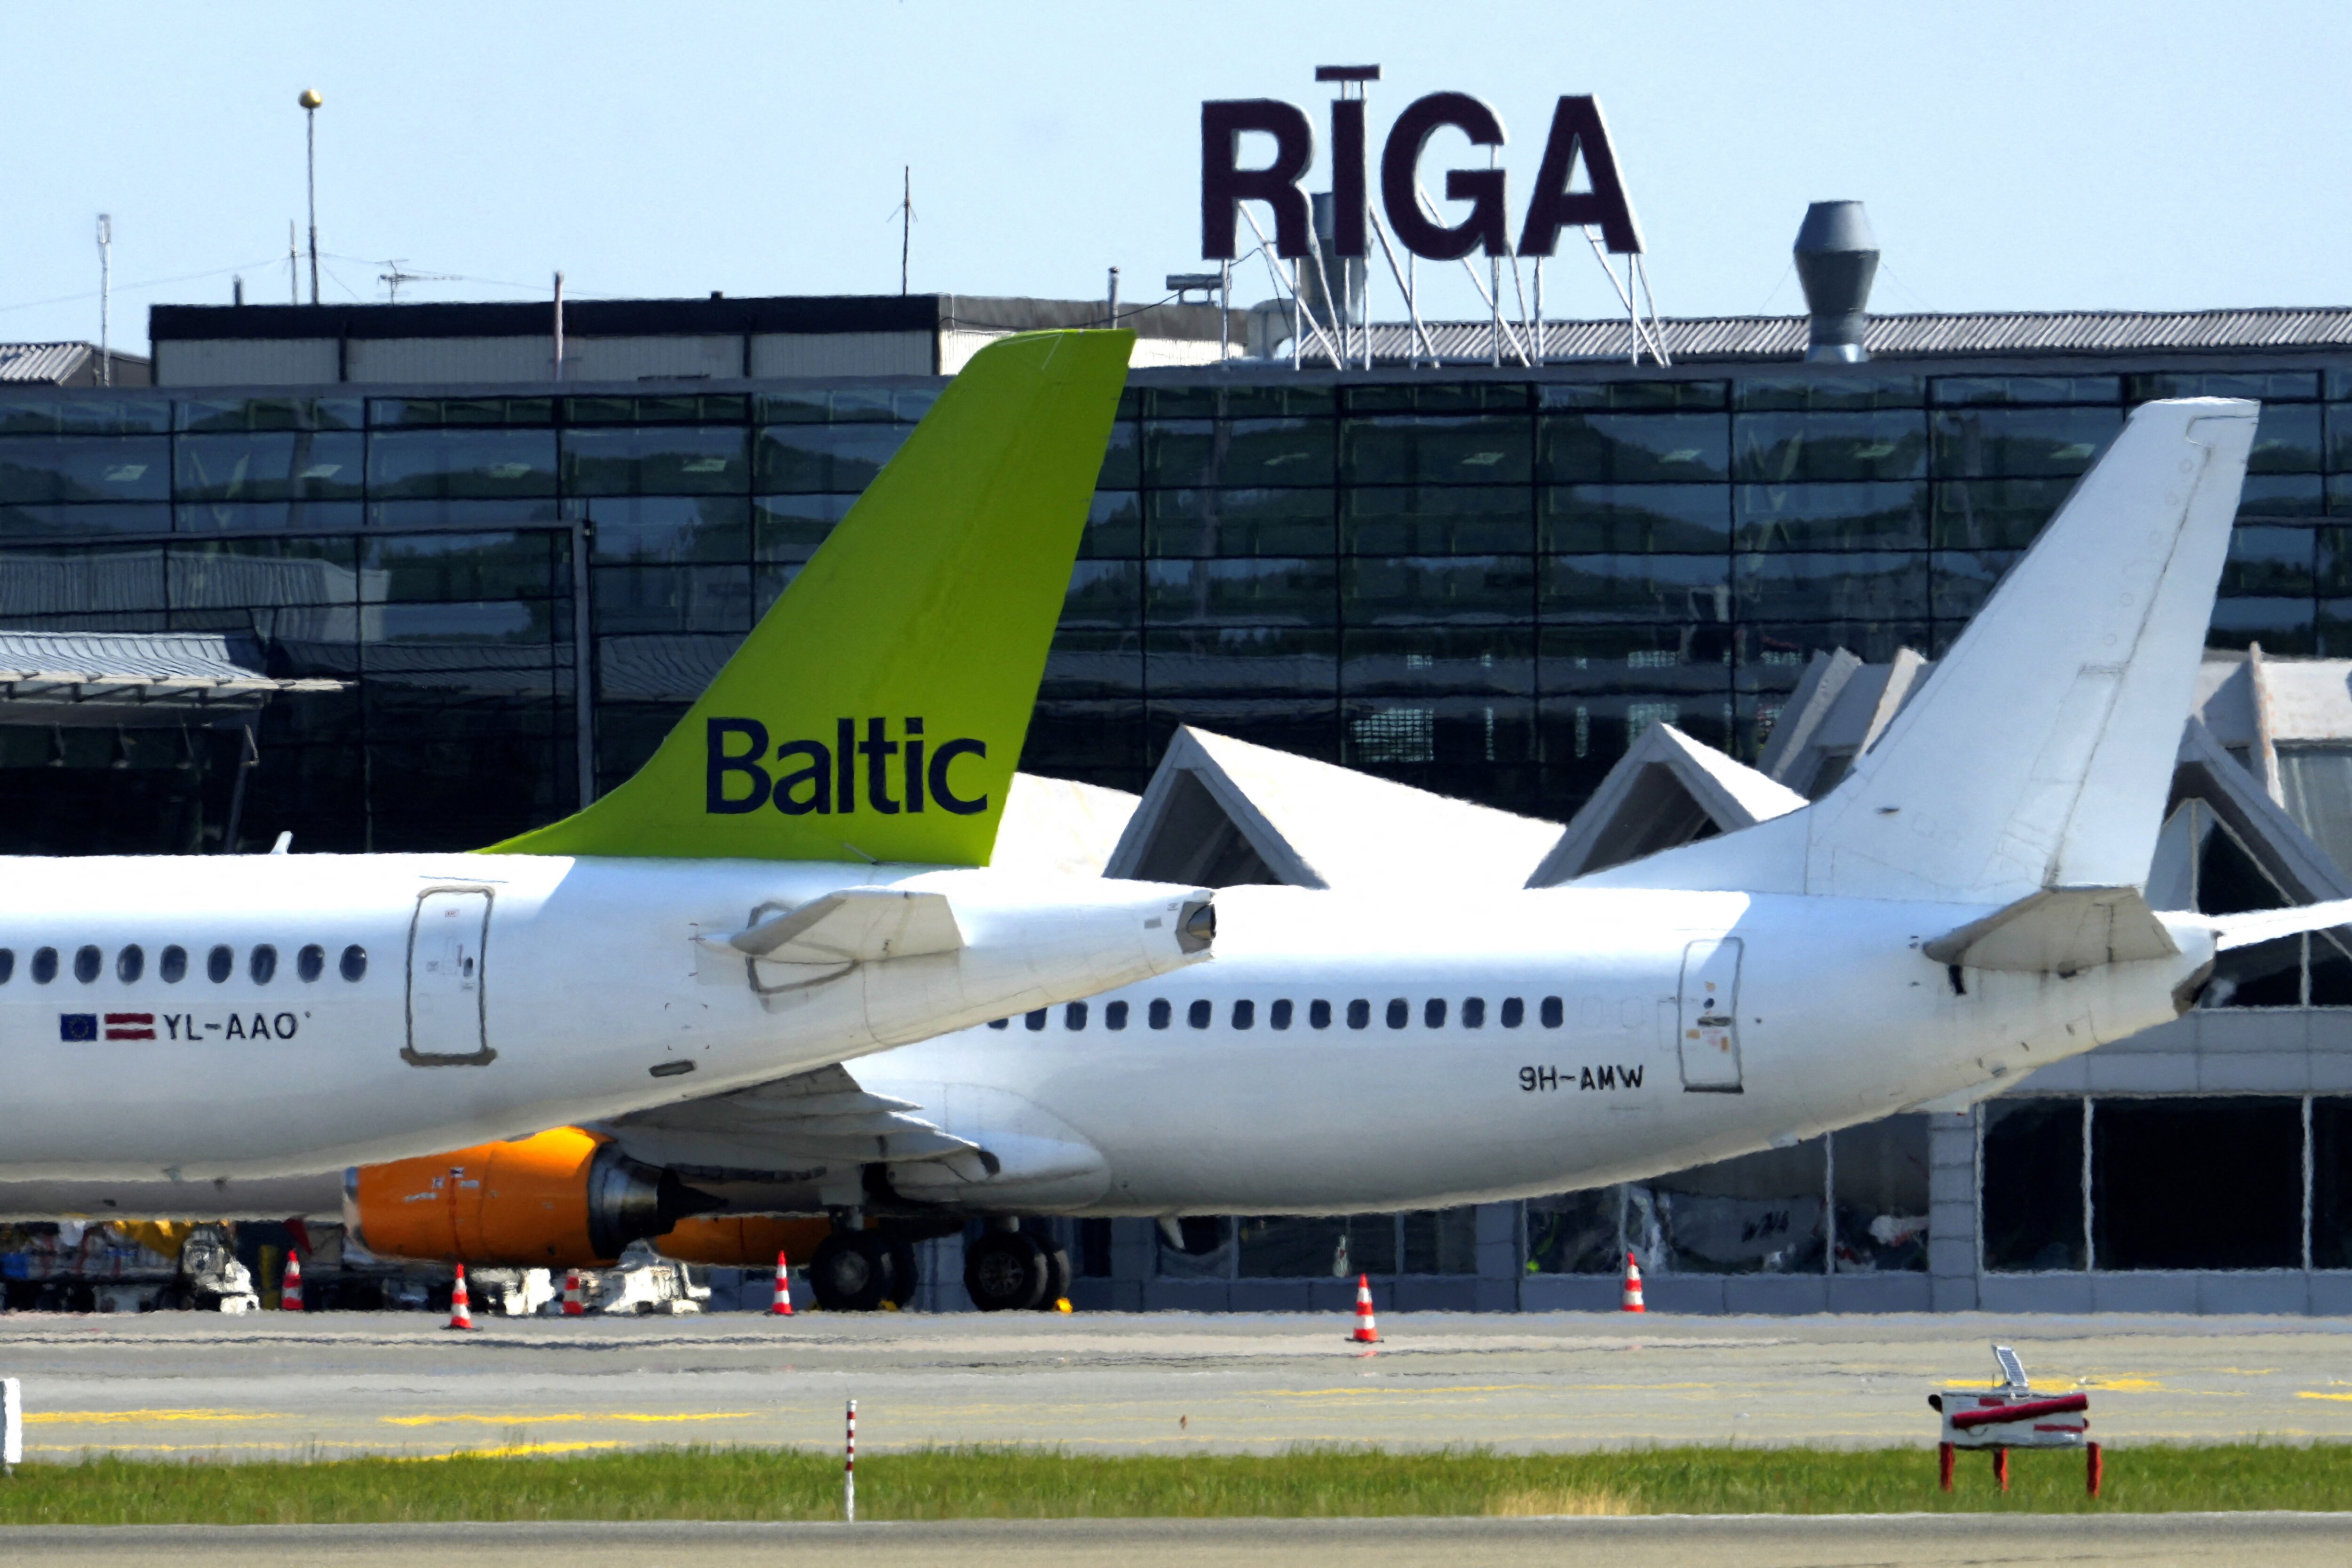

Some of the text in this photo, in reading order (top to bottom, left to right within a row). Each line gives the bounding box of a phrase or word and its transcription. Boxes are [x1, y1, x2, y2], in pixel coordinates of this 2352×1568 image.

[1201, 64, 1645, 260] RĪGA
[706, 716, 987, 815] Baltic
[162, 1011, 299, 1042] YL-AAO
[1518, 1064, 1644, 1092] 9H-AMW
